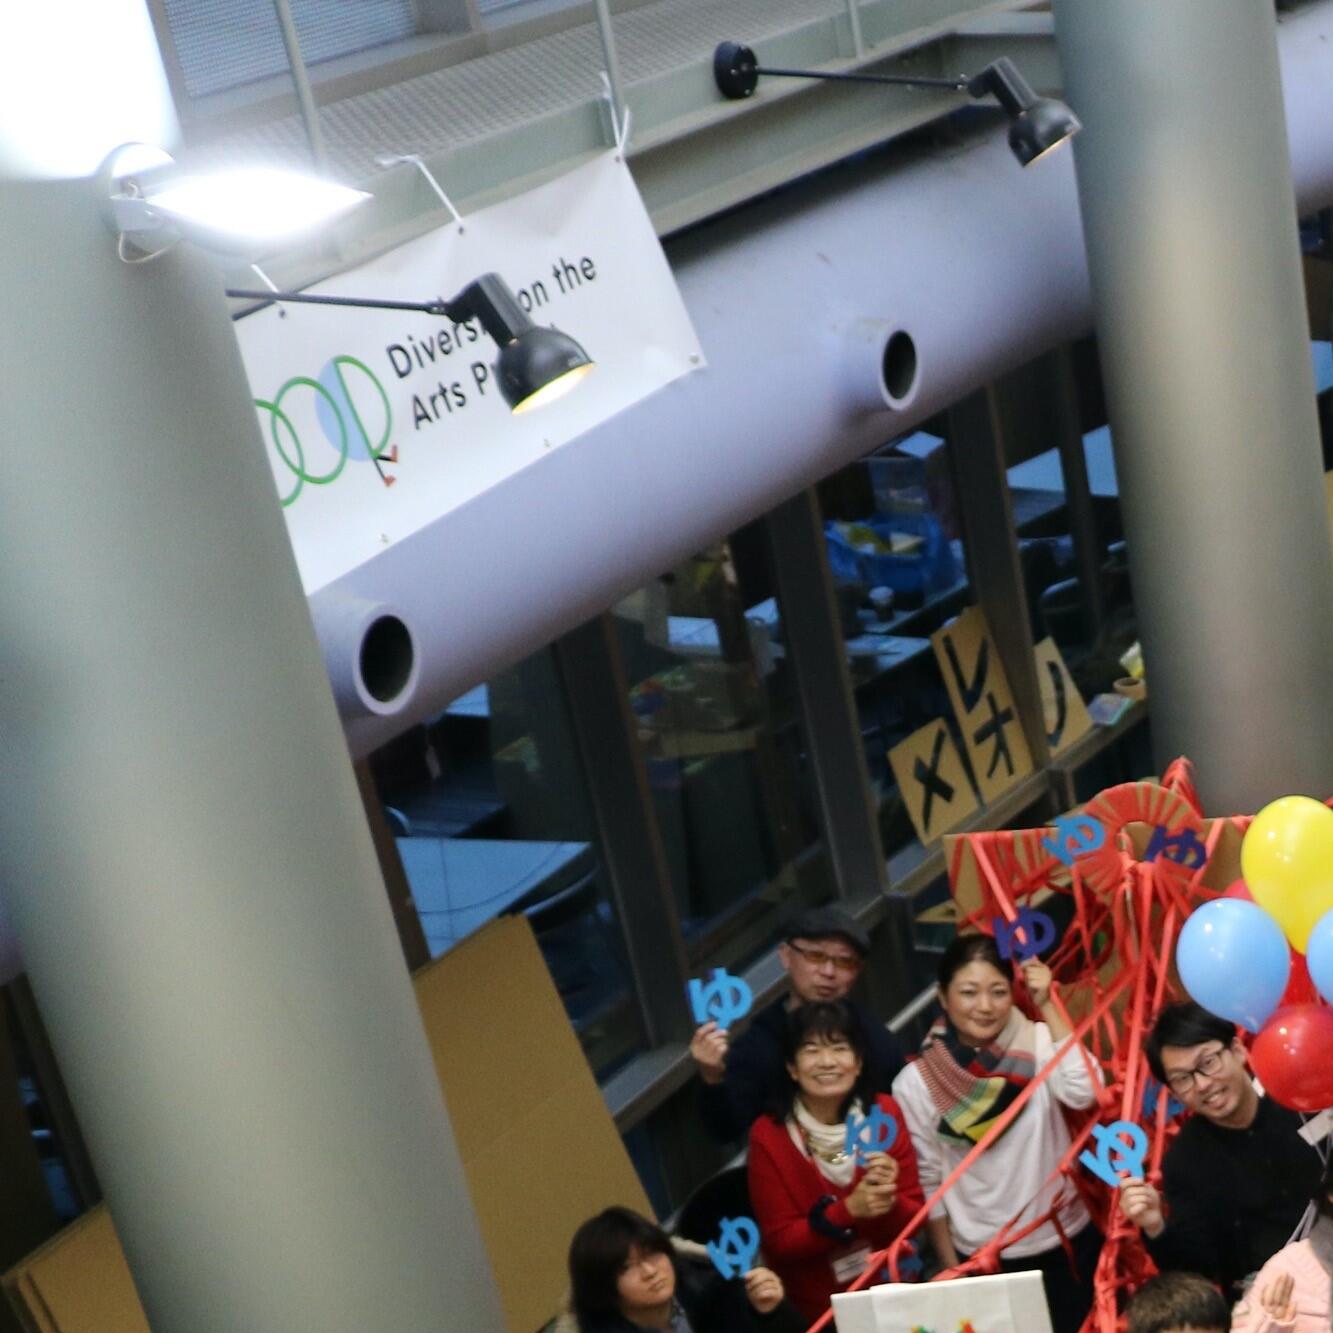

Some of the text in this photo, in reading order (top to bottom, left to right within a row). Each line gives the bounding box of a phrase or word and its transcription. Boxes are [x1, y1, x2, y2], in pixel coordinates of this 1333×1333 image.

[517, 280, 550, 313] on
[552, 256, 597, 294] the
[412, 381, 466, 430] Arts
